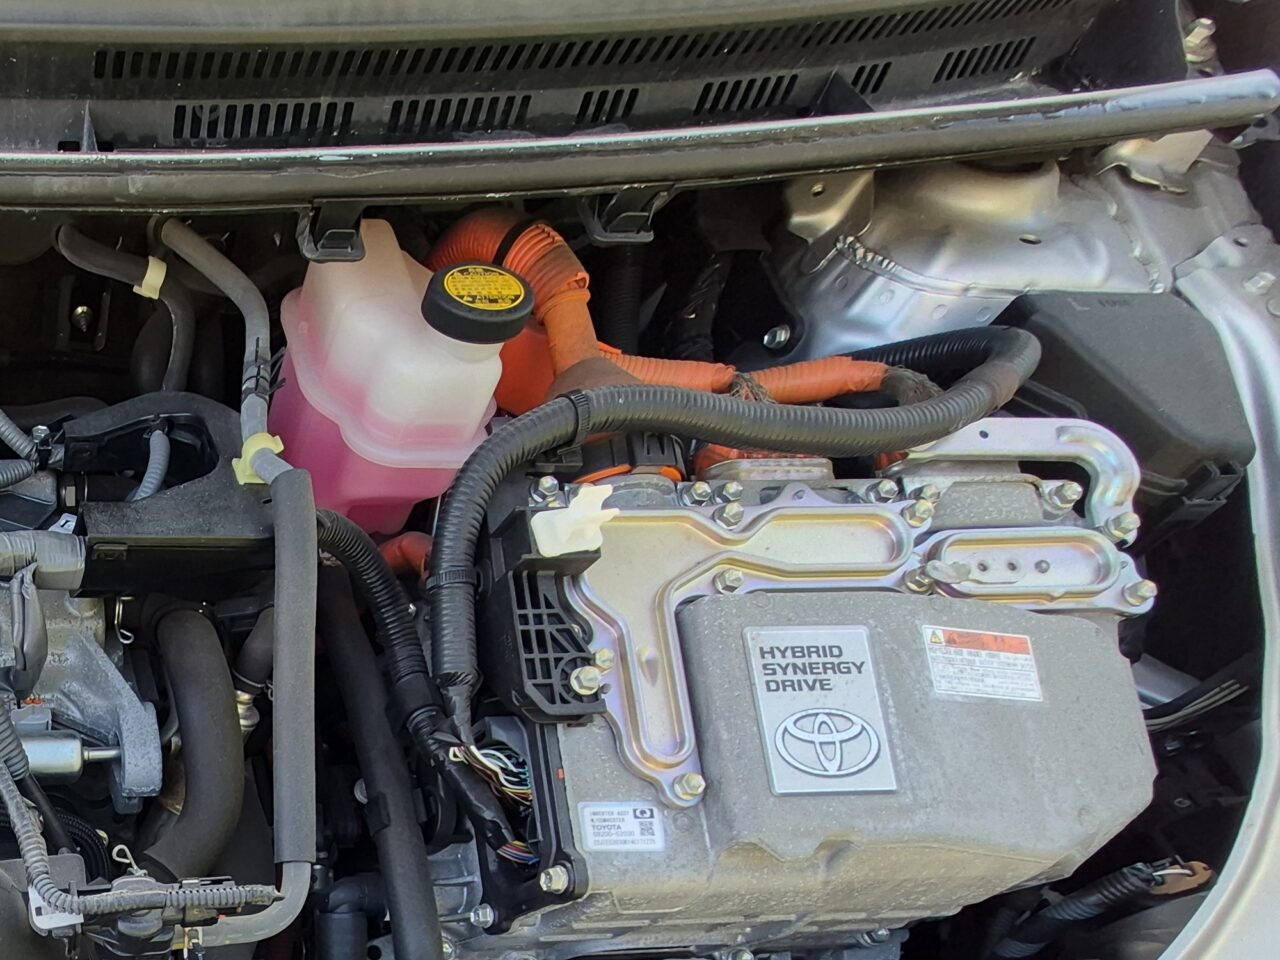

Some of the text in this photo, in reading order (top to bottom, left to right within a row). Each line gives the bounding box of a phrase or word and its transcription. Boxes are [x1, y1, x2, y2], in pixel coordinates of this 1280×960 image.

[759, 645, 843, 659] HYBRID
[762, 661, 865, 676] SYNERGY
[765, 678, 833, 692] DRIVE
